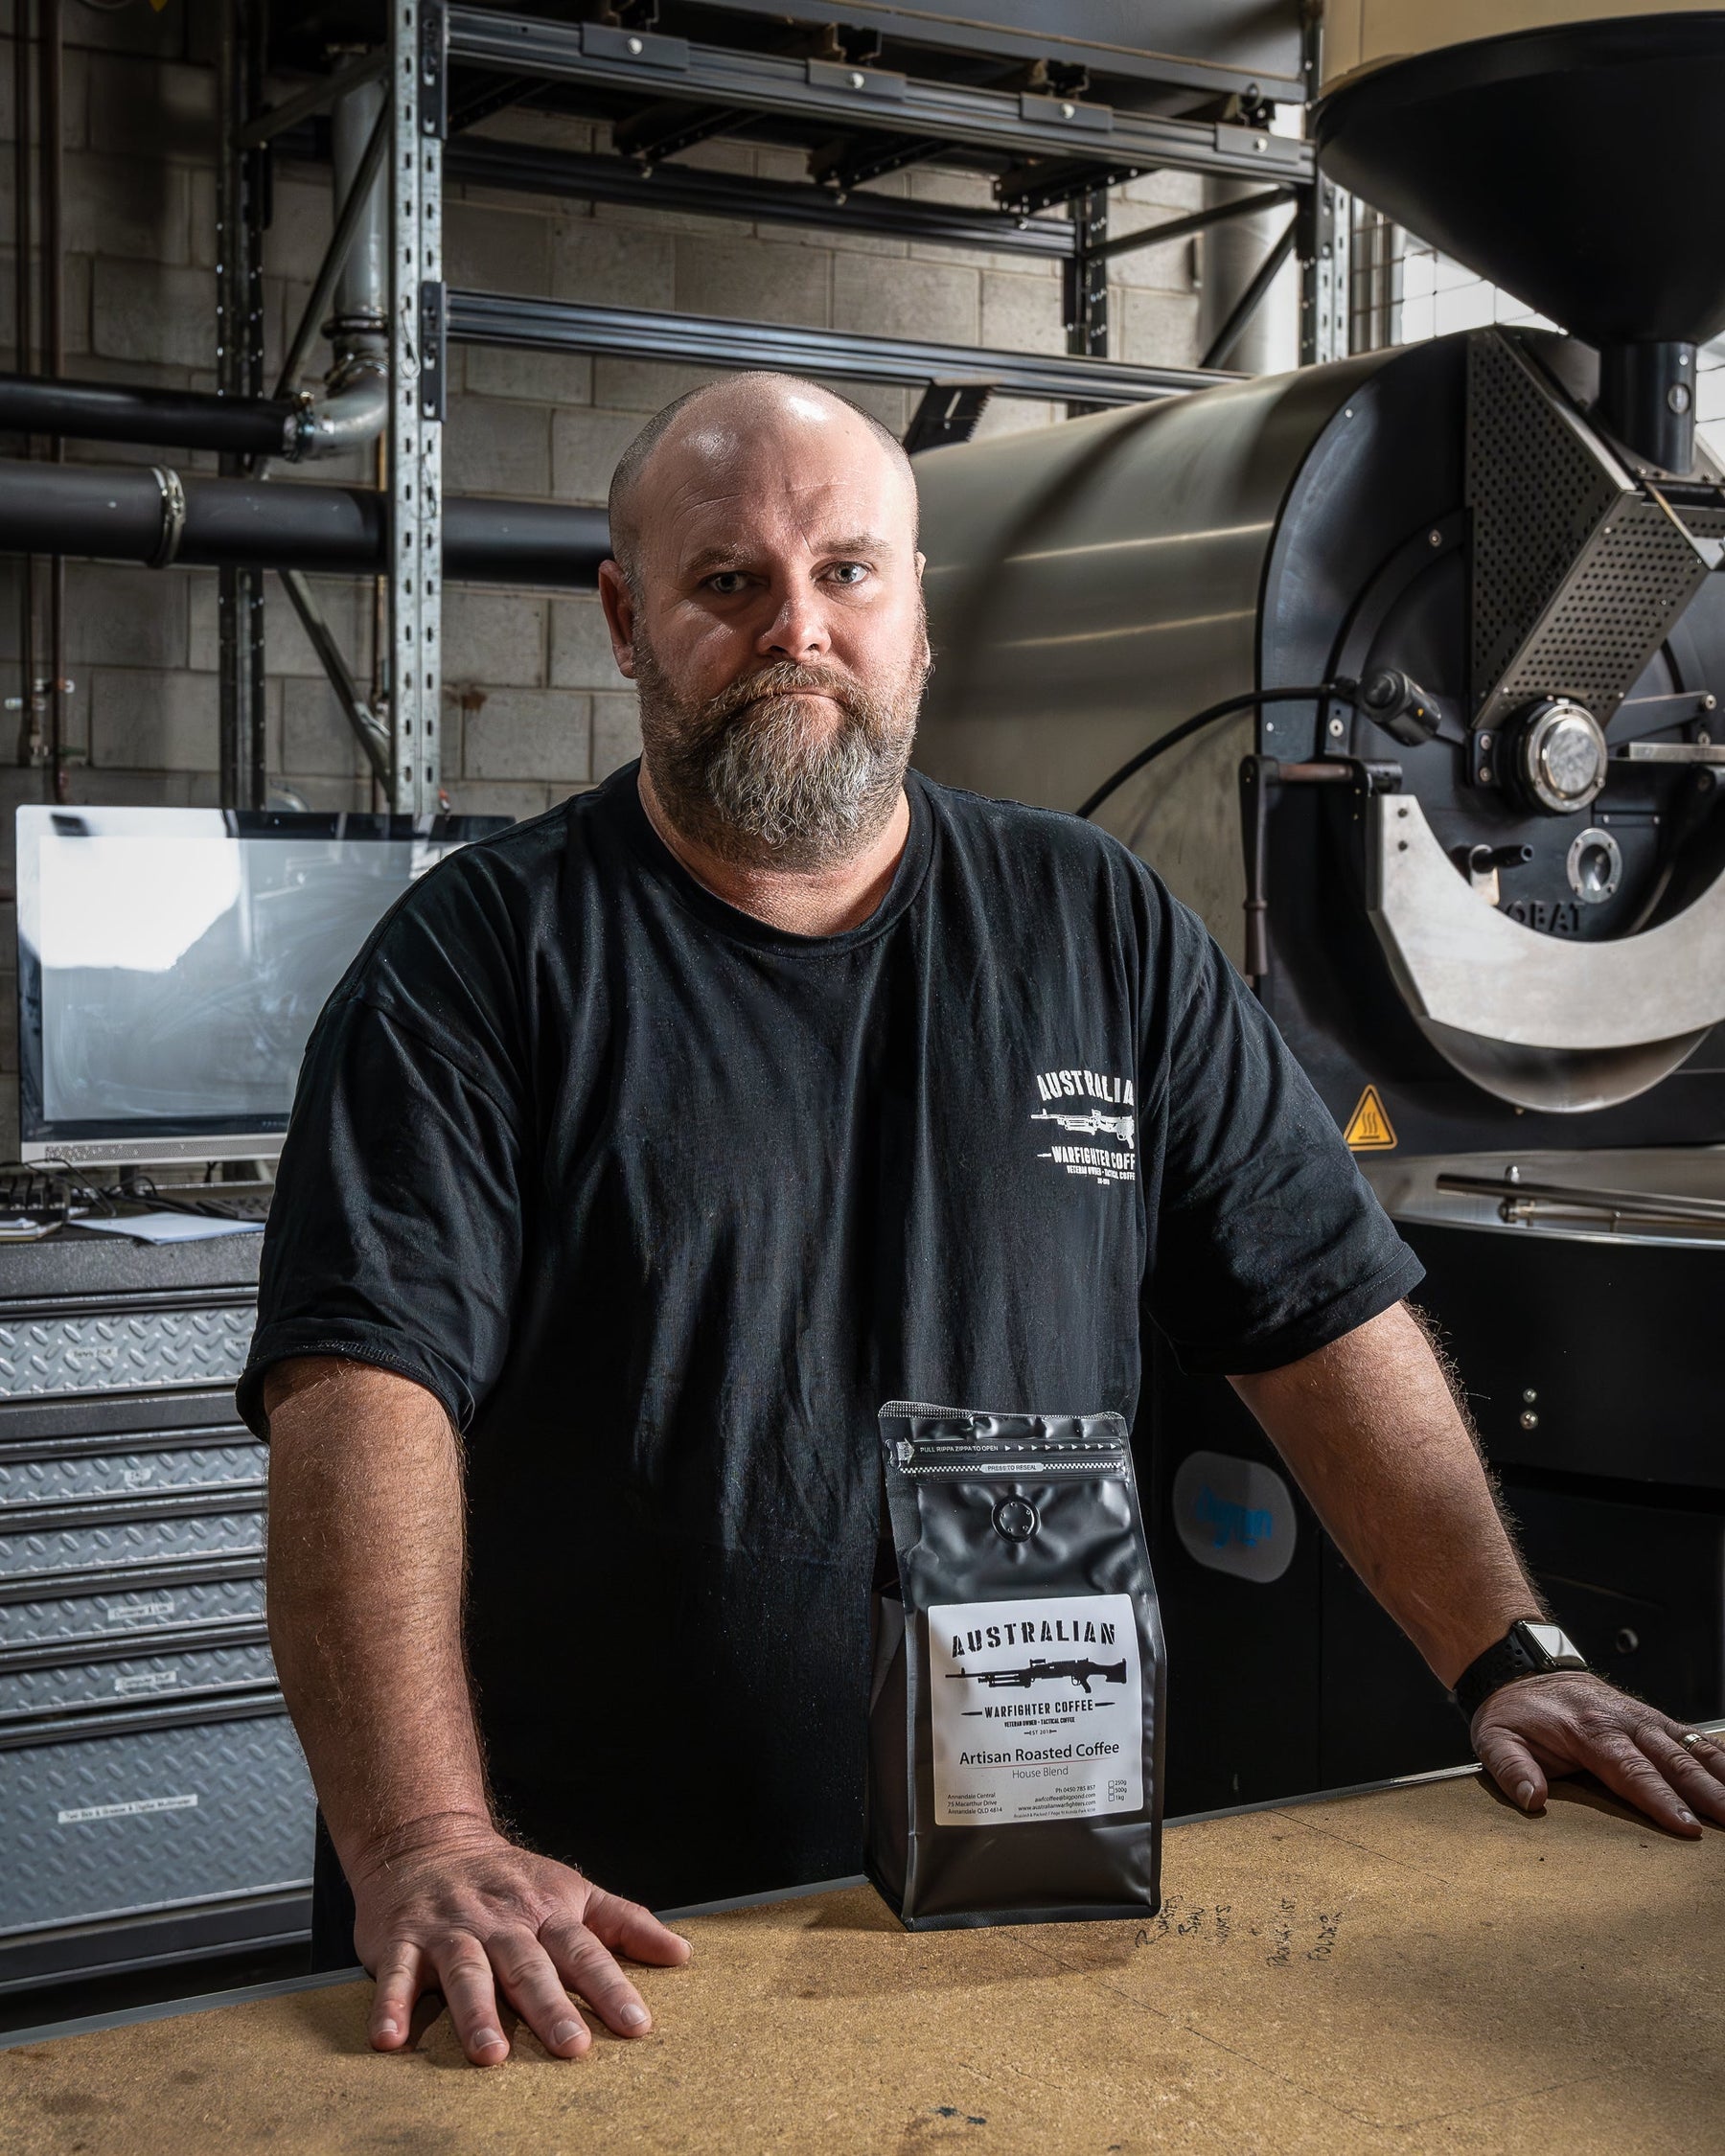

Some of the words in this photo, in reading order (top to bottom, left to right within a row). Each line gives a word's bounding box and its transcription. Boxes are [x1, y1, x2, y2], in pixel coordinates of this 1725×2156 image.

[1037, 1069, 1134, 1106] AUSTRALIA
[1051, 1145, 1111, 1168] WARFIGHTER
[1112, 1152, 1136, 1170] COFF
[952, 1620, 1116, 1658] AUSTRALIAN
[984, 1702, 1051, 1719] WARFIGHTER
[1055, 1699, 1093, 1714] COFFEE
[1040, 1717, 1060, 1726] TACTICAL
[959, 1751, 1011, 1765] Artisan
[1015, 1744, 1072, 1762] Roasted
[1075, 1741, 1120, 1757] Coffee
[1012, 1769, 1042, 1779] House
[1043, 1766, 1069, 1778] Blend
